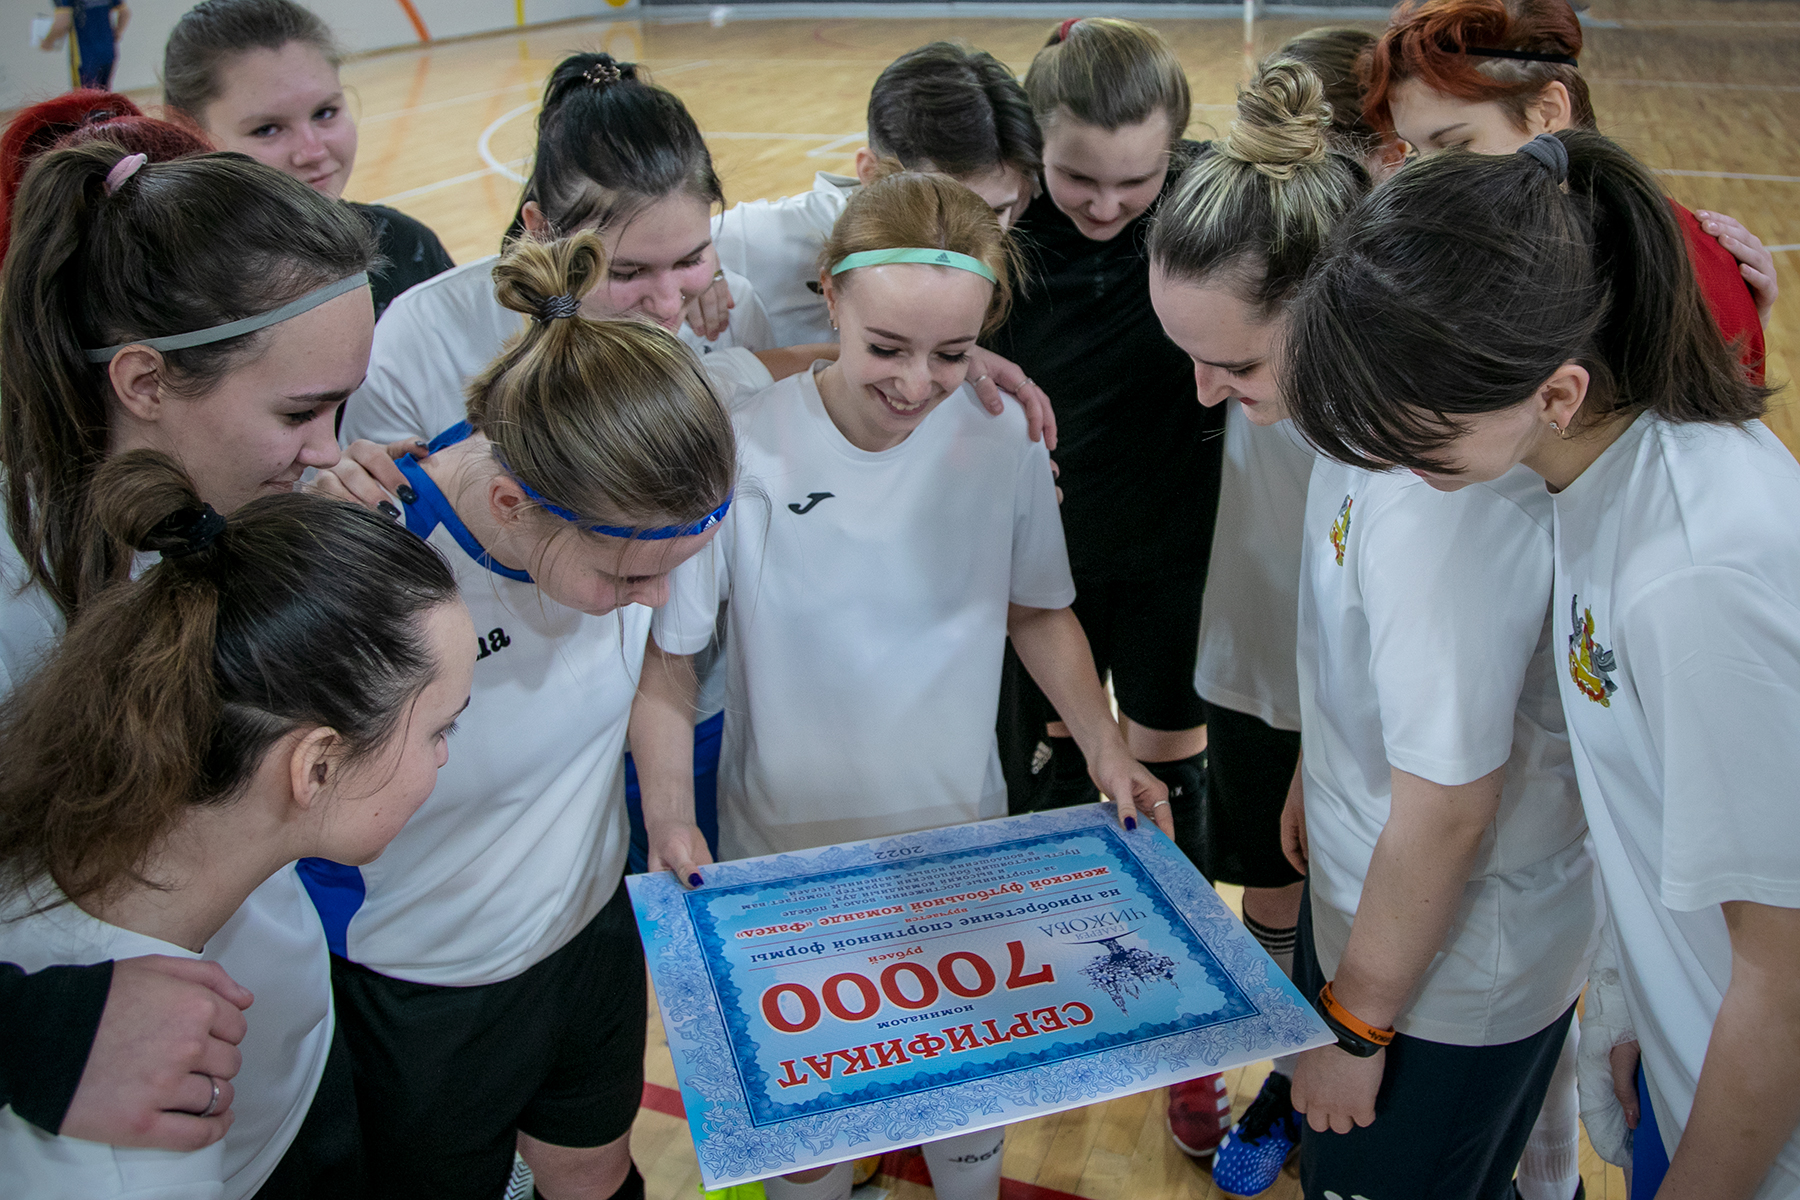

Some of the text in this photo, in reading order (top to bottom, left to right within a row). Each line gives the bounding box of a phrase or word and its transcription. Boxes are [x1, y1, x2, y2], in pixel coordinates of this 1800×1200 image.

[874, 846, 925, 860] 2022
[1044, 848, 1081, 859] Пусть
[974, 856, 1040, 873] настоящий
[966, 868, 1040, 886] спортивные
[736, 867, 1109, 939] женской футбольной команде «Факел»
[741, 902, 766, 911] вам
[770, 892, 831, 906] помогает
[781, 905, 827, 918] победе
[904, 908, 968, 923] вручается
[750, 888, 1121, 963] на приобретение спортивной формы
[1037, 907, 1147, 937] ЧИЖОВА
[1075, 925, 1125, 940] ГАЛЕРЕЯ
[867, 946, 924, 964] рублей
[761, 940, 1055, 1033] 70000
[877, 1005, 974, 1029] номиналом
[777, 1001, 1094, 1089] СЕРТИФИКАТ
